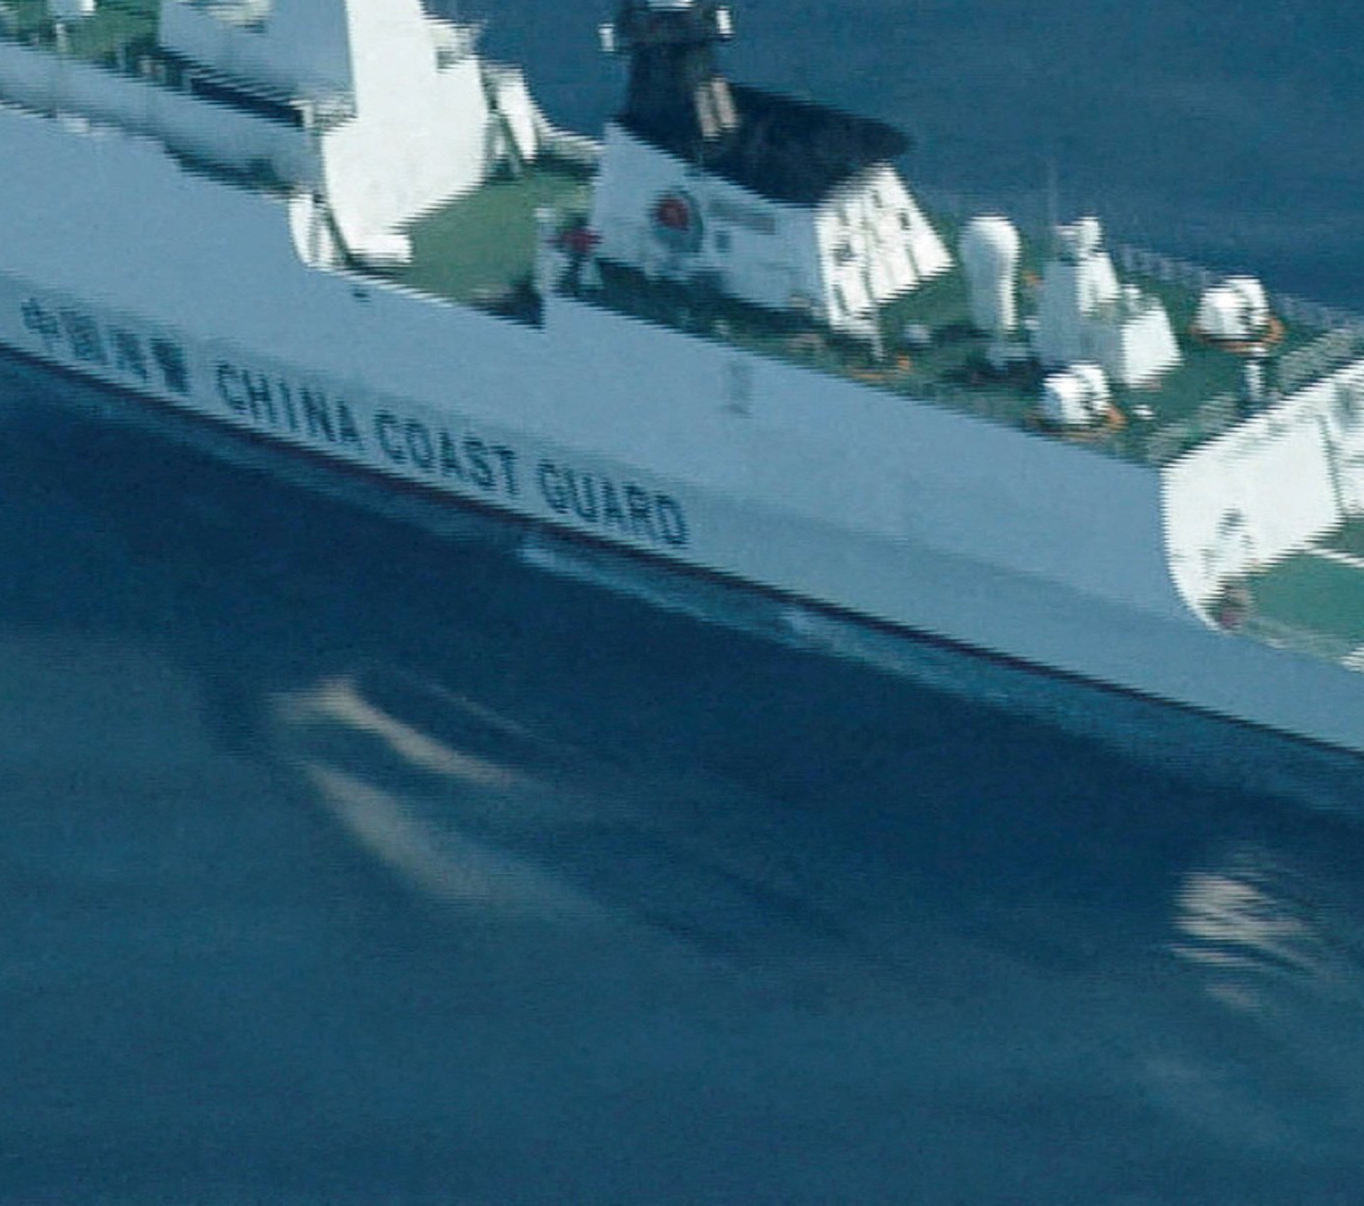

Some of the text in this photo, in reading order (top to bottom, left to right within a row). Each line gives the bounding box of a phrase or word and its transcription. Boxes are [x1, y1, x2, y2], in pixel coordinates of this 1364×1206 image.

[215, 360, 689, 549] CHINA COAST GUARD
